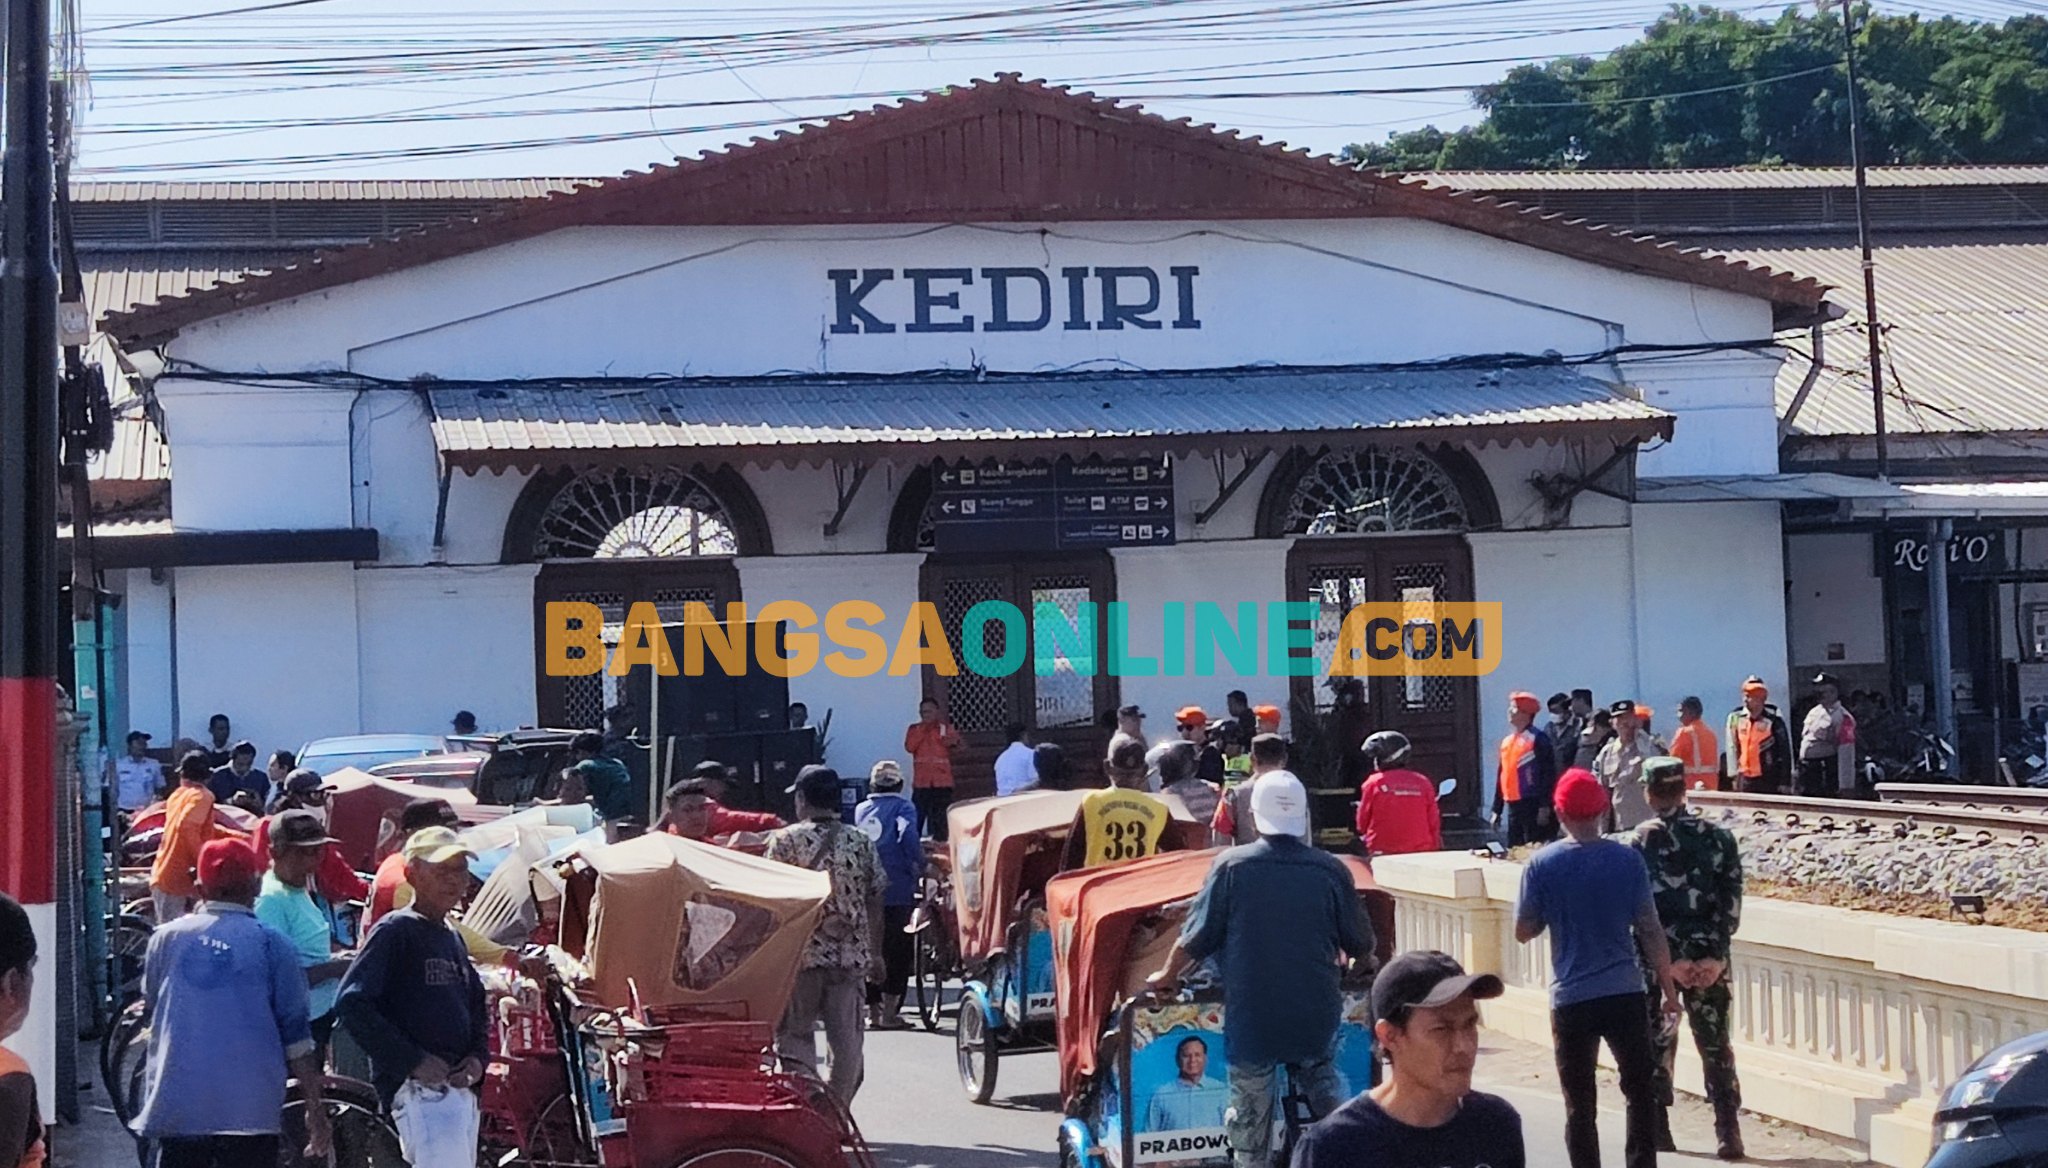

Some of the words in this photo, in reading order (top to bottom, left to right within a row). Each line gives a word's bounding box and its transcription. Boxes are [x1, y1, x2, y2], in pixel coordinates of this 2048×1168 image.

[827, 266, 1201, 334] KEDIRI
[1110, 496, 1130, 504] ATM
[1894, 536, 1988, 571] Roi'O
[1104, 821, 1146, 860] 33
[1140, 1133, 1230, 1155] PRABOW
